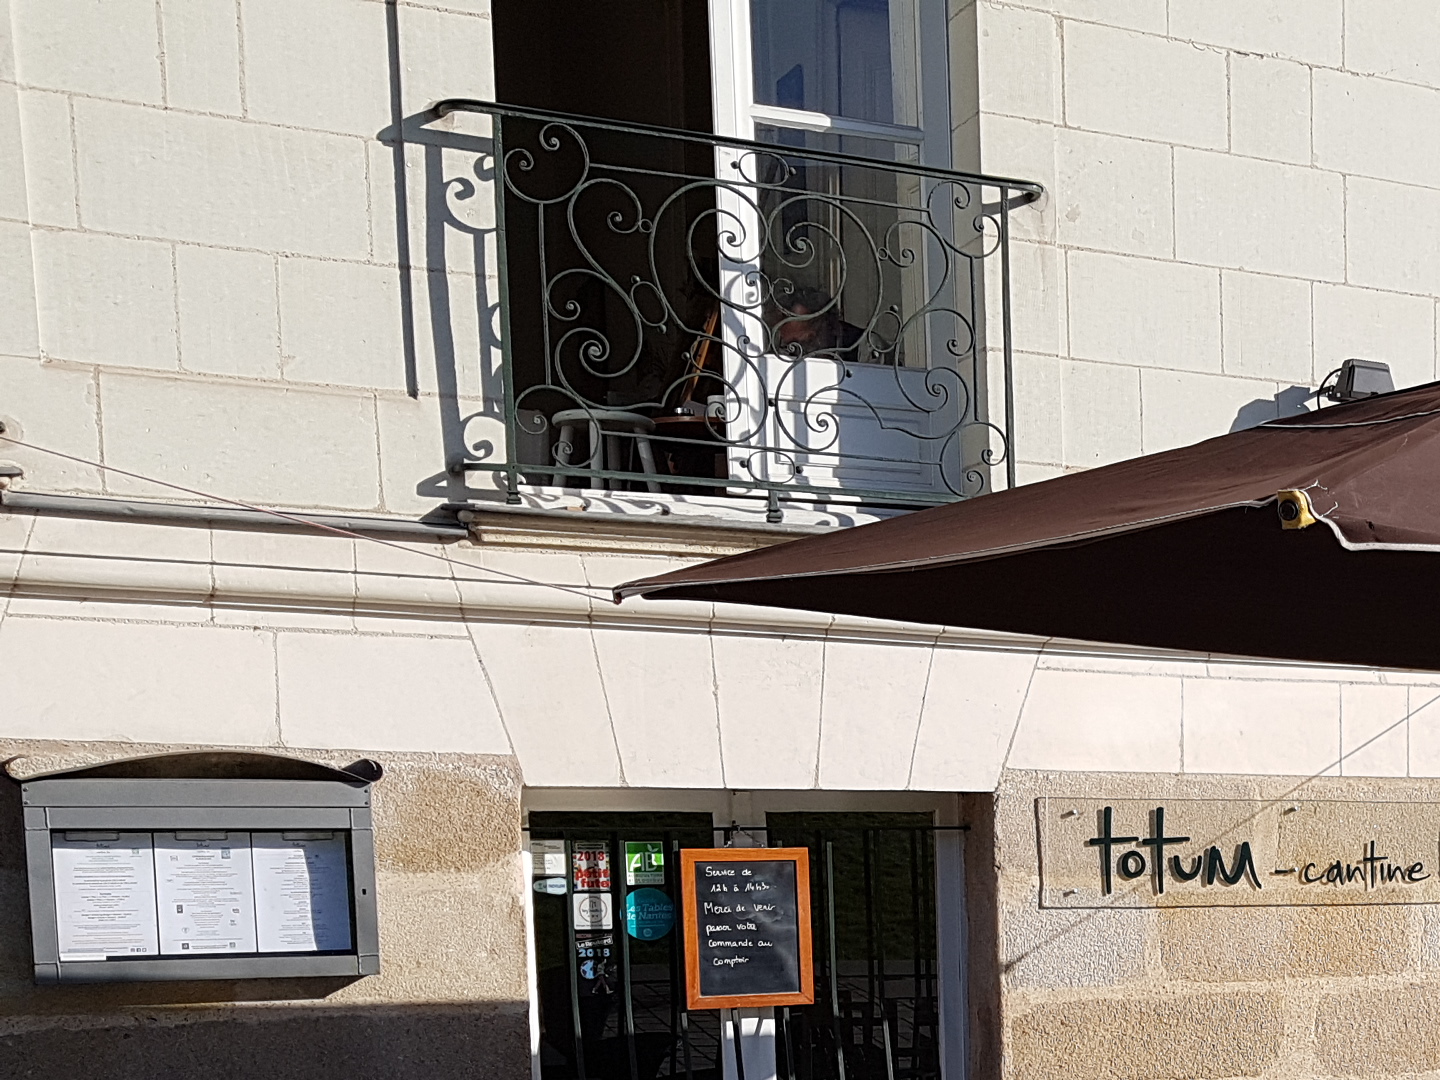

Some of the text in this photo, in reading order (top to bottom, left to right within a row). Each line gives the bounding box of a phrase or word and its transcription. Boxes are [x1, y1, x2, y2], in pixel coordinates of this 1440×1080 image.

[577, 850, 605, 861] 2018
[575, 867, 610, 881] petit
[705, 866, 752, 877] Service de
[710, 883, 728, 892] 12h
[703, 902, 732, 915] Merci
[736, 904, 746, 912] de
[578, 948, 610, 957] 2018
